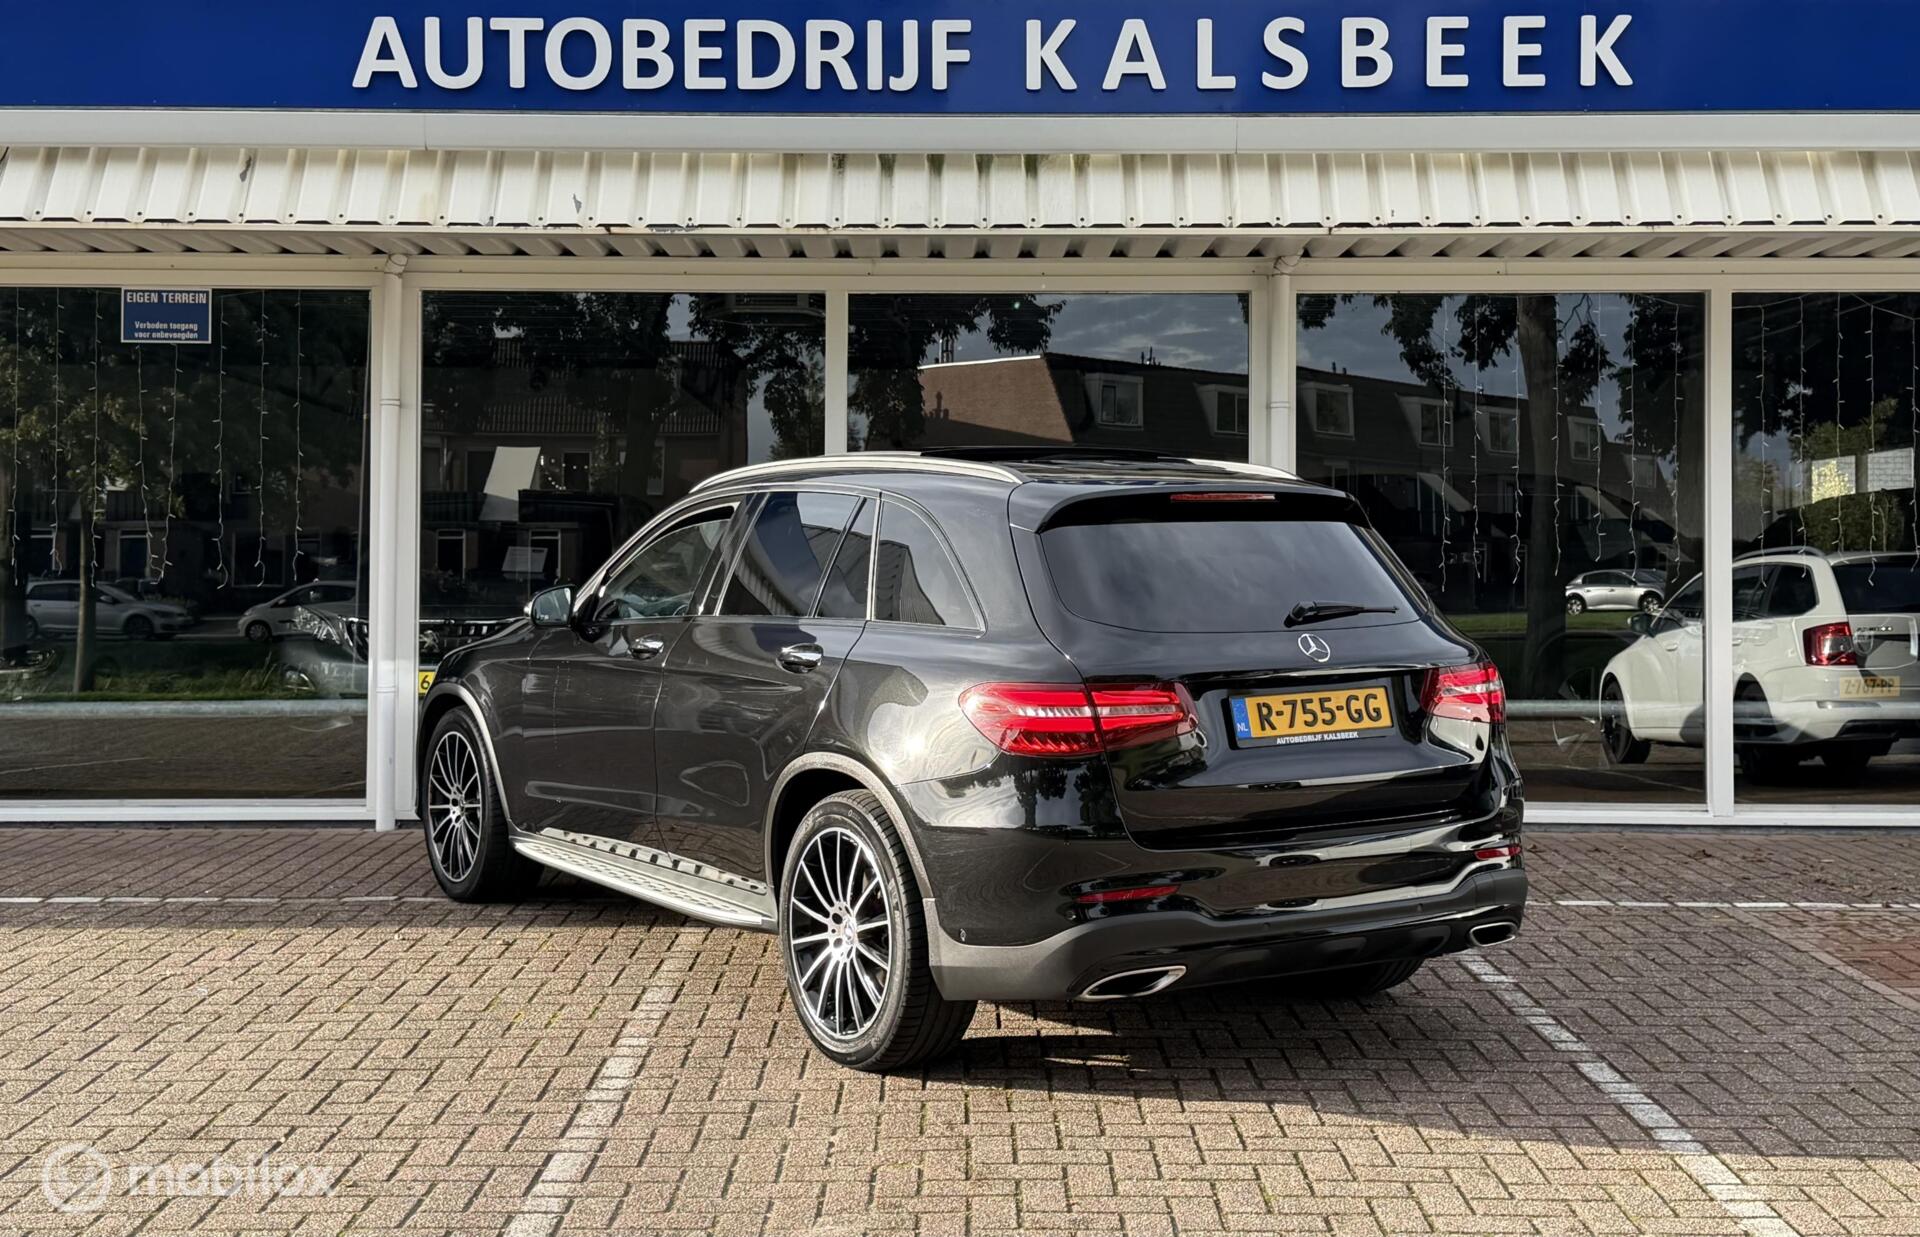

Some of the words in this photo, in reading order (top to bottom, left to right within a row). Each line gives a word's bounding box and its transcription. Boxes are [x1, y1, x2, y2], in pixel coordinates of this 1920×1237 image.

[351, 16, 973, 92] AUTOBEDRIJF
[1025, 14, 1634, 91] KALSBEEK
[126, 291, 159, 304] EIGEN
[161, 292, 207, 304] TERREIN
[134, 321, 168, 330] Verboden
[169, 322, 198, 332] toegang
[151, 331, 198, 340] onbevoegden
[1256, 693, 1382, 732] R-755-GG
[1236, 722, 1249, 732] NL
[1276, 733, 1323, 745] AUTOBEDRIJF
[1323, 731, 1359, 740] KALSBEEK
